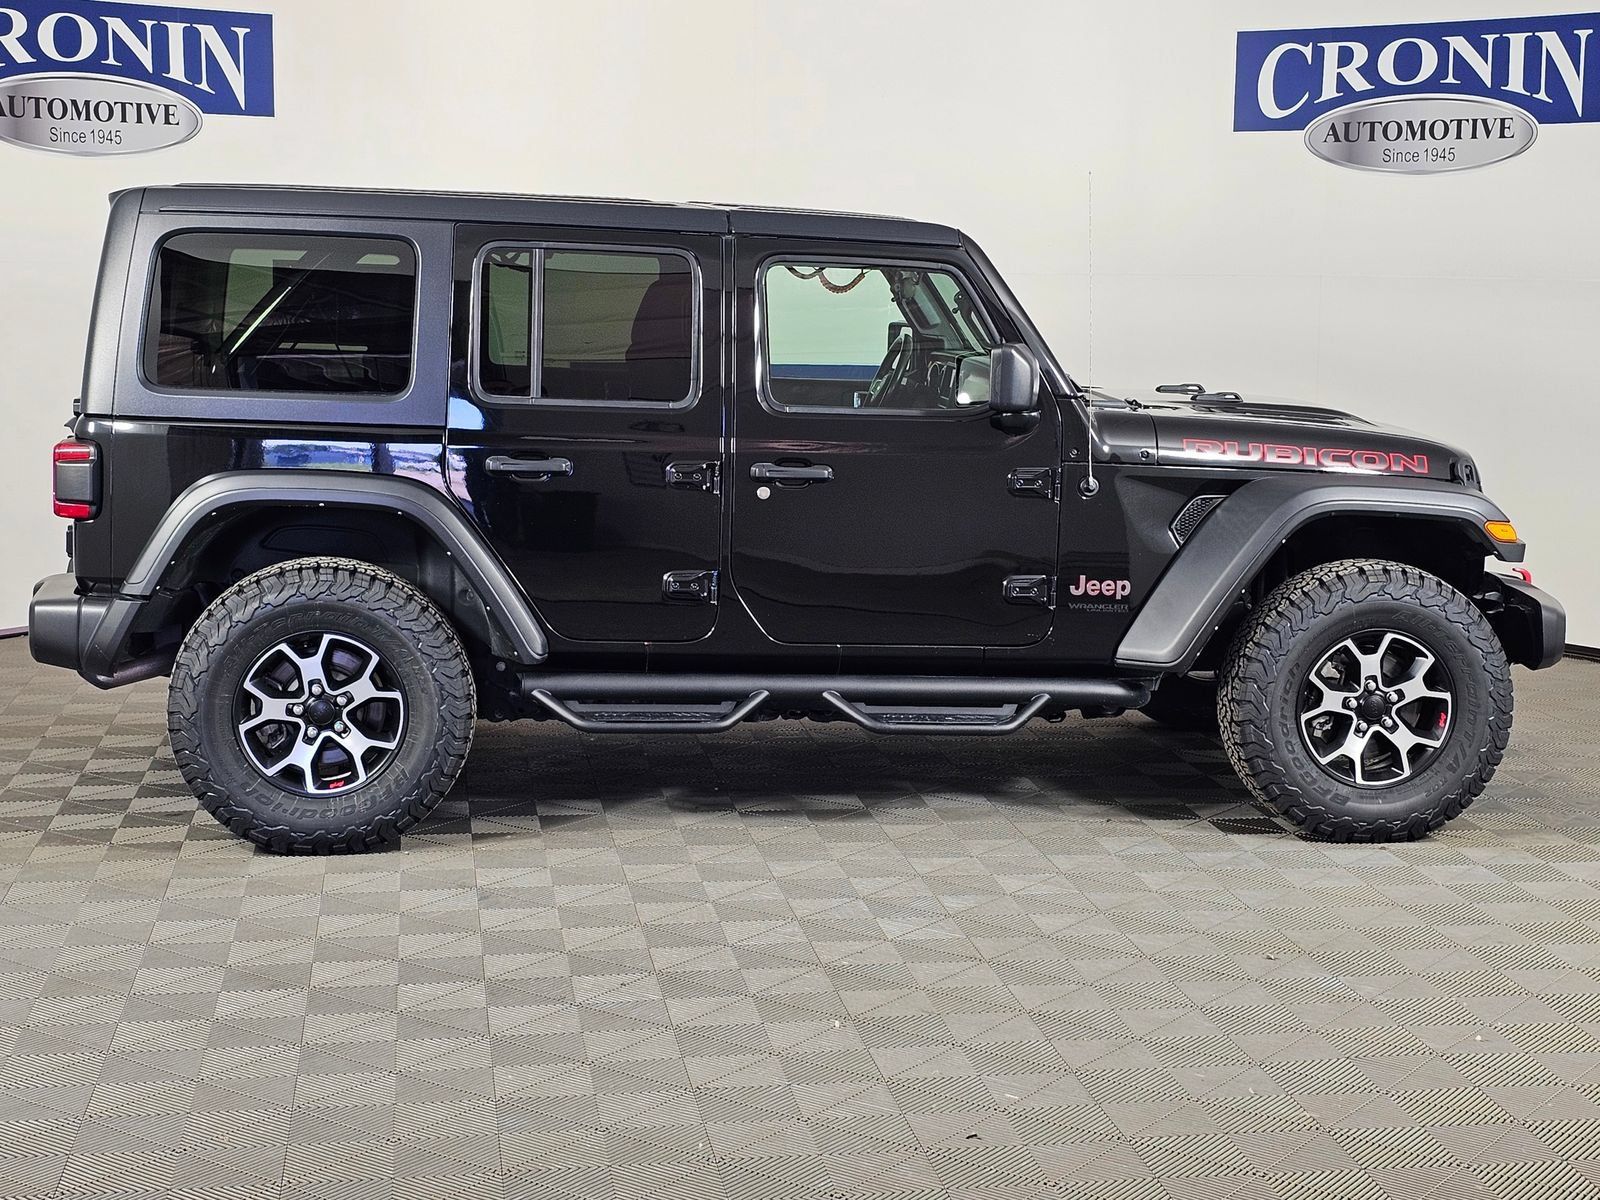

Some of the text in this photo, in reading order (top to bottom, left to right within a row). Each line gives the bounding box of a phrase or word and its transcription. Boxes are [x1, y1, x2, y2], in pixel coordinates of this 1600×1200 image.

[1257, 29, 1593, 118] CRONIN
[50, 127, 122, 145] Since 1945
[1323, 117, 1515, 143] AUTOMOTIVE
[1382, 147, 1456, 163] Since 1945
[1183, 439, 1428, 473] RUBICON
[1069, 574, 1131, 600] Jeep
[1068, 602, 1129, 610] WRANGLER
